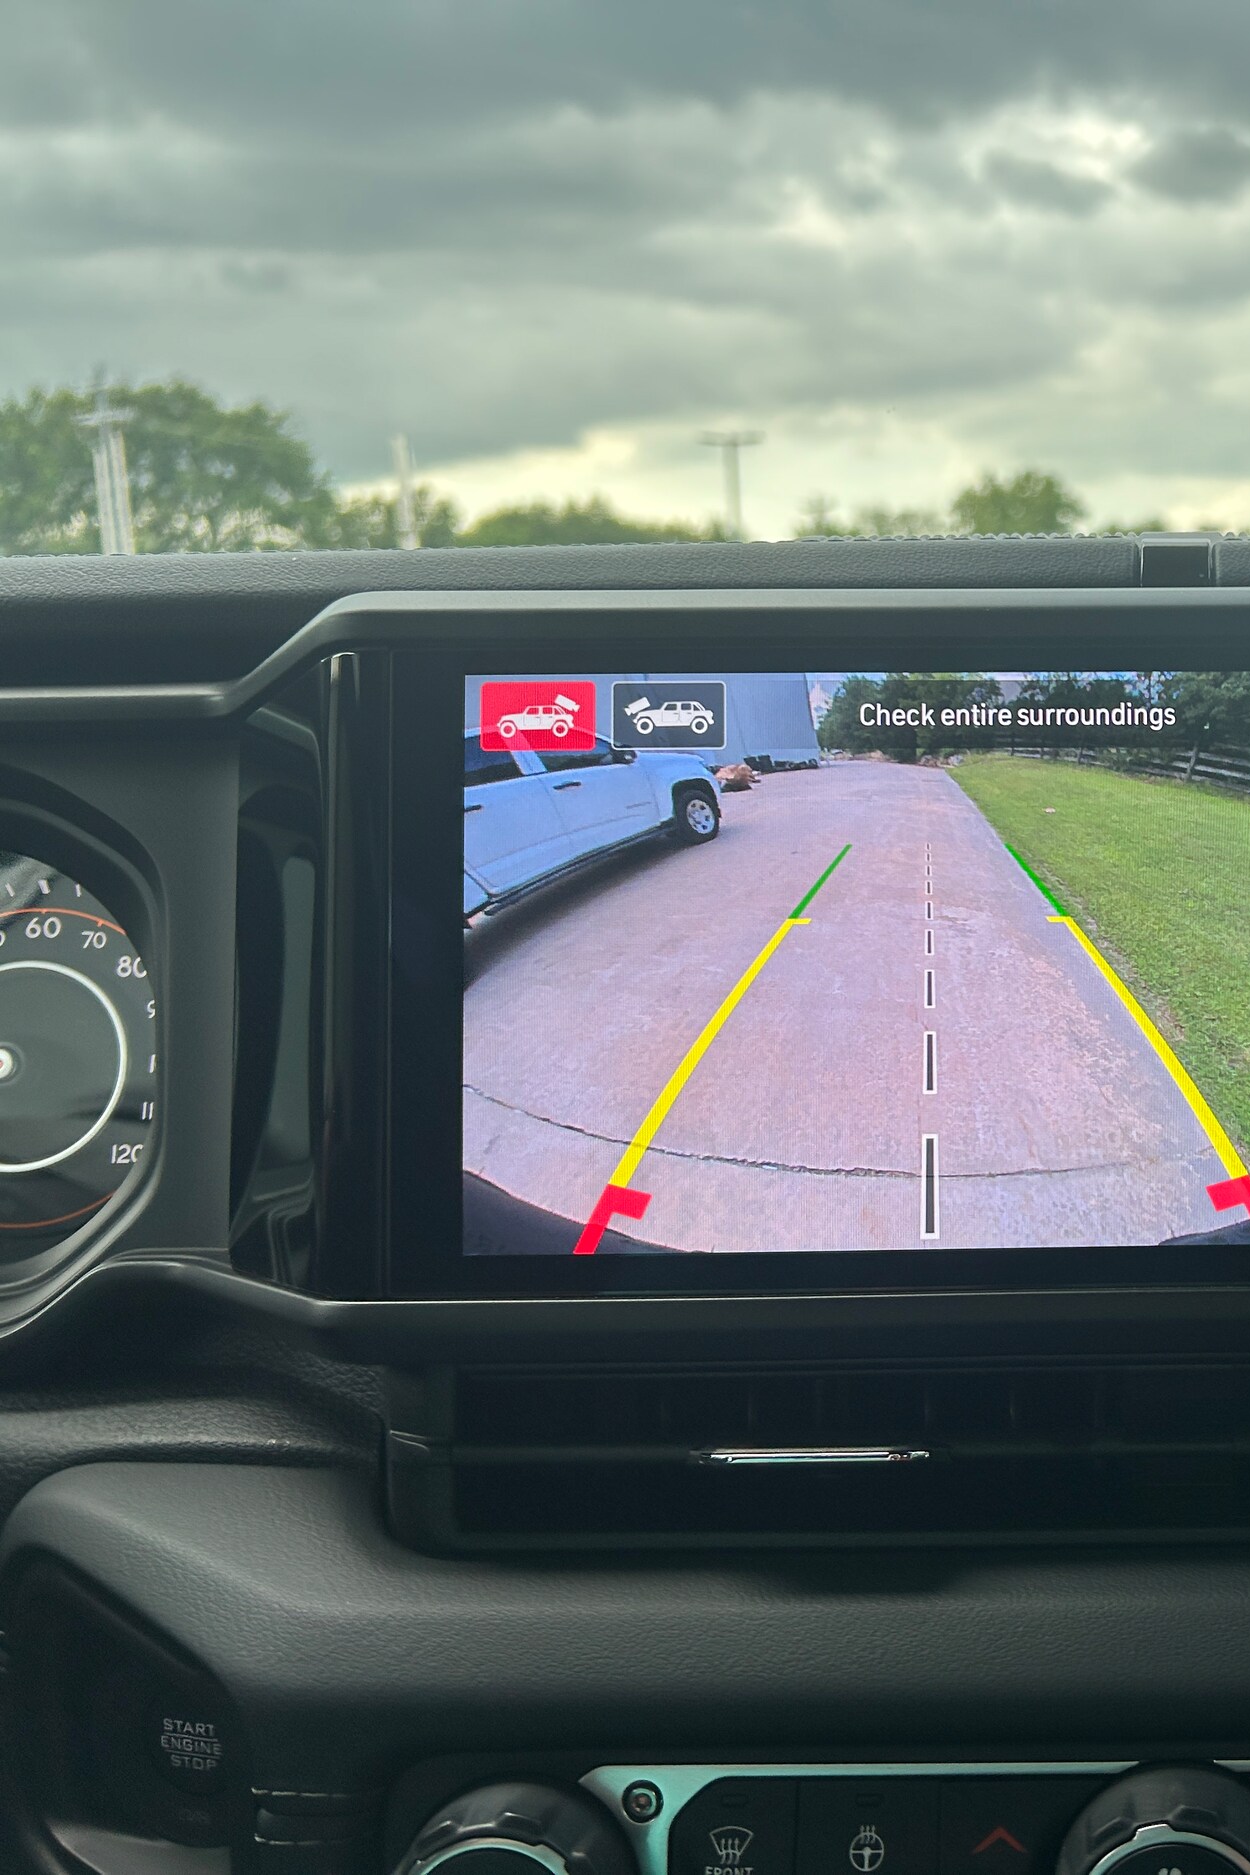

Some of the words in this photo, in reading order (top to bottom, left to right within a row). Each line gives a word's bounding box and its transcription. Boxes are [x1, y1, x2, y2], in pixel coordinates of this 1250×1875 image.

[859, 702, 935, 727] Check
[940, 702, 1012, 727] entire
[1016, 702, 1176, 731] surroundings
[25, 916, 62, 939] 60
[81, 931, 107, 949] 70
[163, 1718, 215, 1737] START
[161, 1735, 223, 1756] ENGINE
[170, 1754, 217, 1771] STOP
